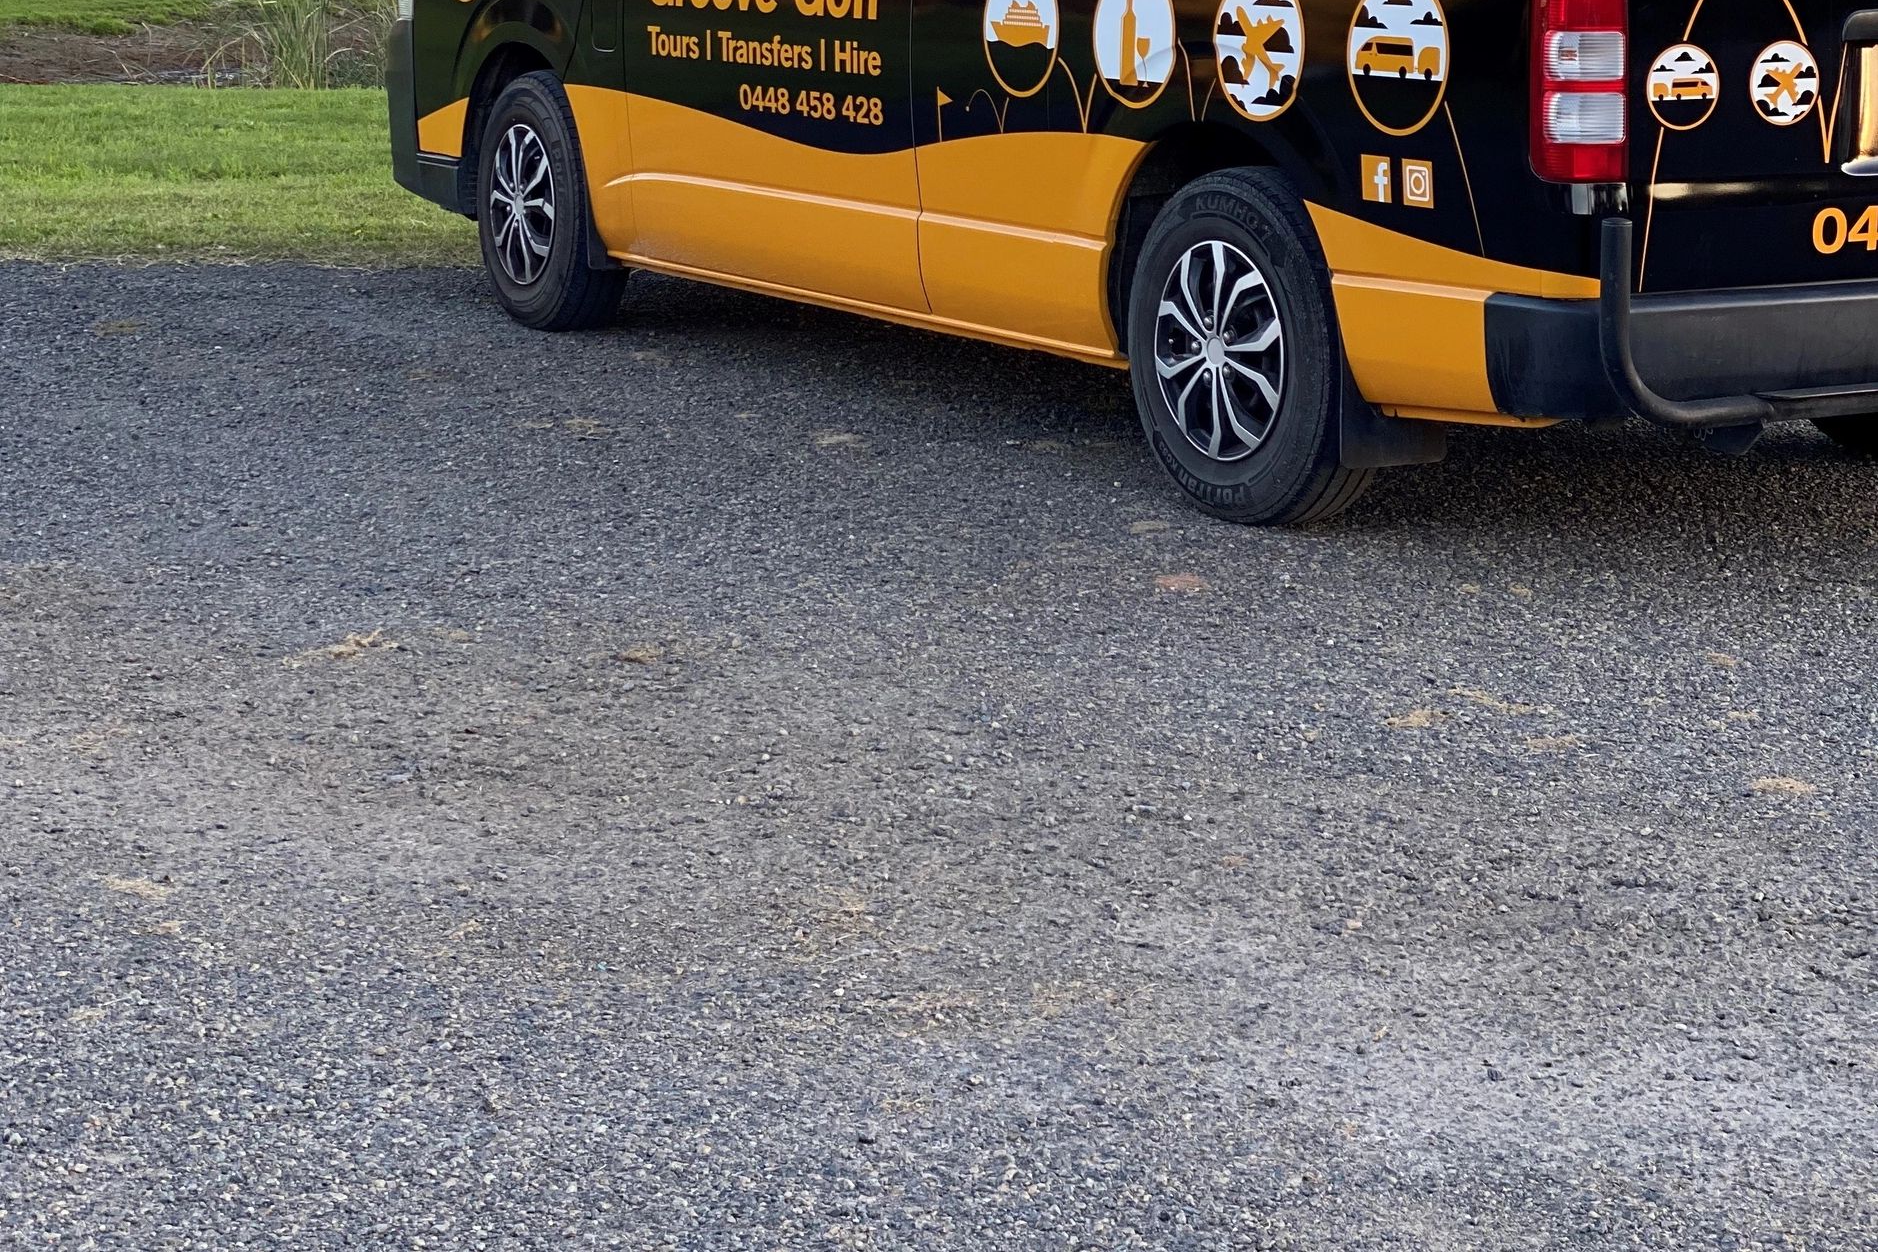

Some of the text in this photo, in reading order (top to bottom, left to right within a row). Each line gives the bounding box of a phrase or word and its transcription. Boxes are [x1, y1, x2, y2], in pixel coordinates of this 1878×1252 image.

[647, 24, 700, 59] Tours
[717, 30, 813, 69] Transfers
[834, 41, 882, 76] Hire
[739, 83, 885, 126] 0448 458 428
[1195, 194, 1259, 229] KUMHO
[1811, 205, 1878, 254] 04
